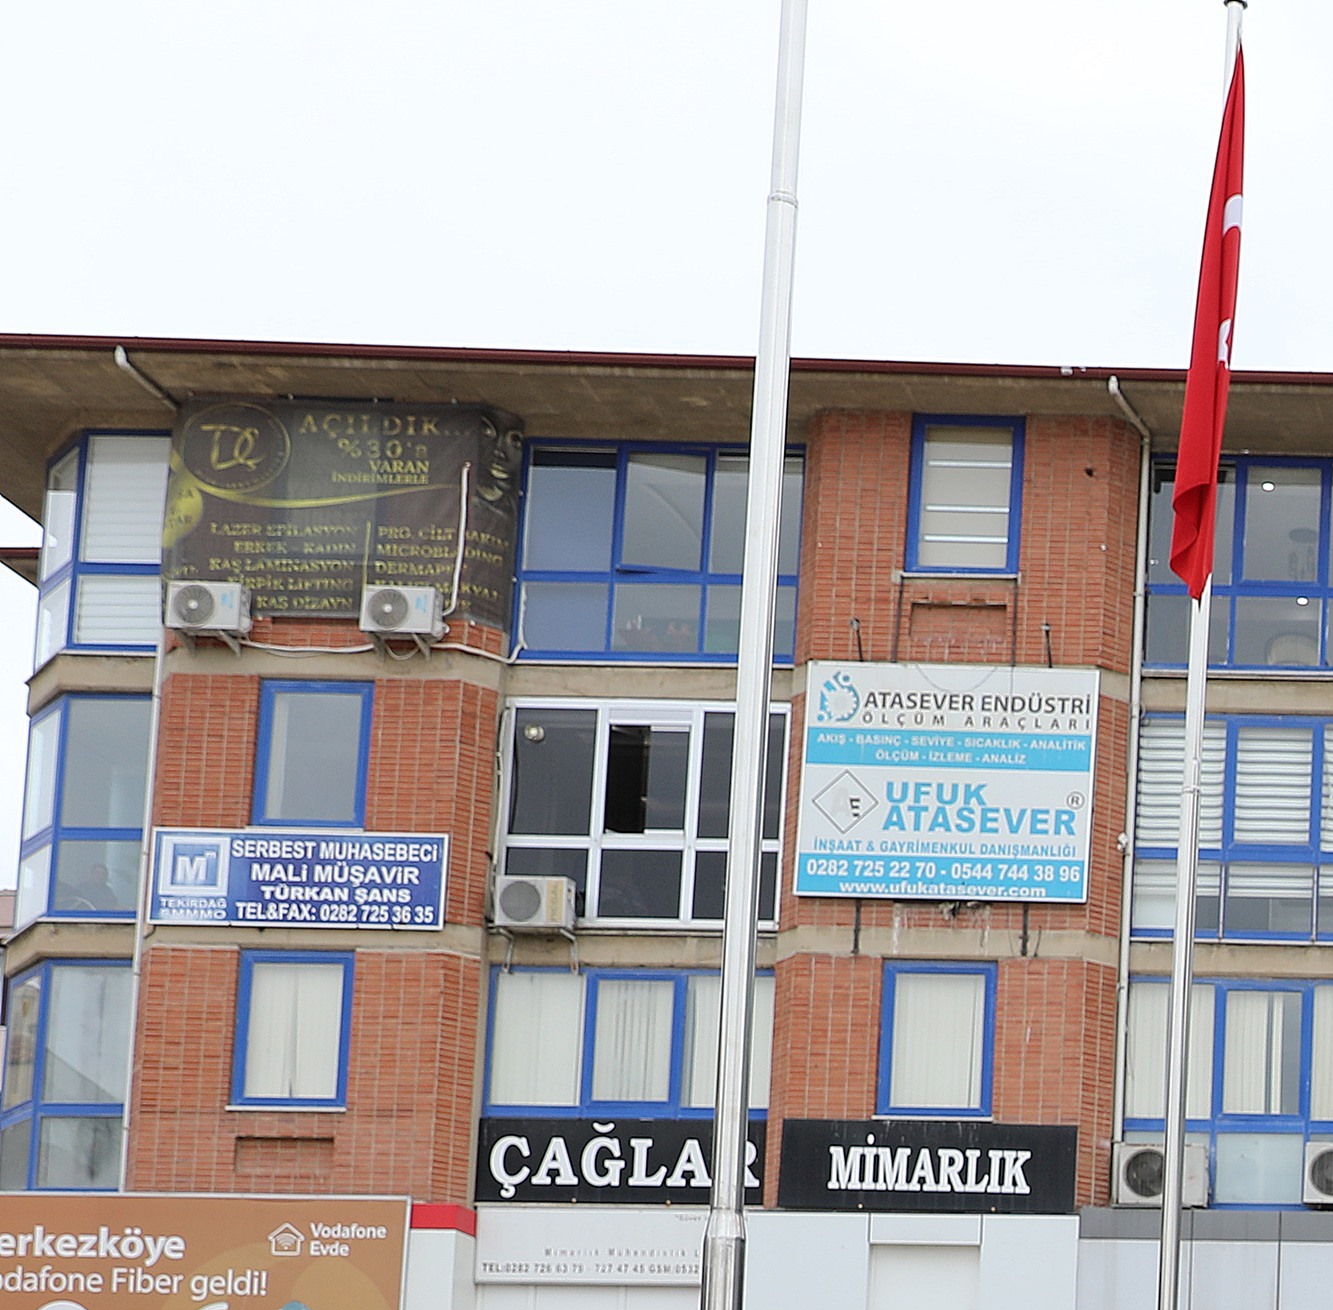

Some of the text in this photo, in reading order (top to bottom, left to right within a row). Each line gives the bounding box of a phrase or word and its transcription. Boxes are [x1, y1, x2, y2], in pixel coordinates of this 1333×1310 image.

[368, 459, 430, 474] VARAN
[863, 691, 1092, 715] ATASEVER ENDÜSTRİ
[862, 711, 1091, 731] ÖLÇÜM ARAÇLARI
[1030, 738, 1086, 751] ANALİTİK
[875, 748, 1027, 765] ÖLÇÜM İZLEME ANALİZ
[885, 780, 988, 806] UFUK
[882, 806, 1077, 837] ATASEVER
[231, 839, 438, 863] SERBEST MUHASEBECİ
[813, 836, 861, 855] İNŞAAT
[880, 838, 975, 856] GAYRİMENKUL
[979, 841, 1077, 859] DANIŞMANLIĞI
[250, 860, 420, 887] MALİ MÜŞAVİR
[806, 859, 1081, 882] 0282 725 22 70 0544 744 38 96
[260, 884, 412, 905] TÜRKAN ŞANS
[839, 879, 1047, 898] www.ufukatasever.com
[235, 902, 434, 924] TEL&FAX: 0282 725 36 35
[828, 1133, 1032, 1195] MİMARLIK
[310, 1222, 387, 1241] Vodafone
[310, 1241, 350, 1258] Evde
[111, 1266, 184, 1294] Fiber
[189, 1268, 269, 1302] geldi!
